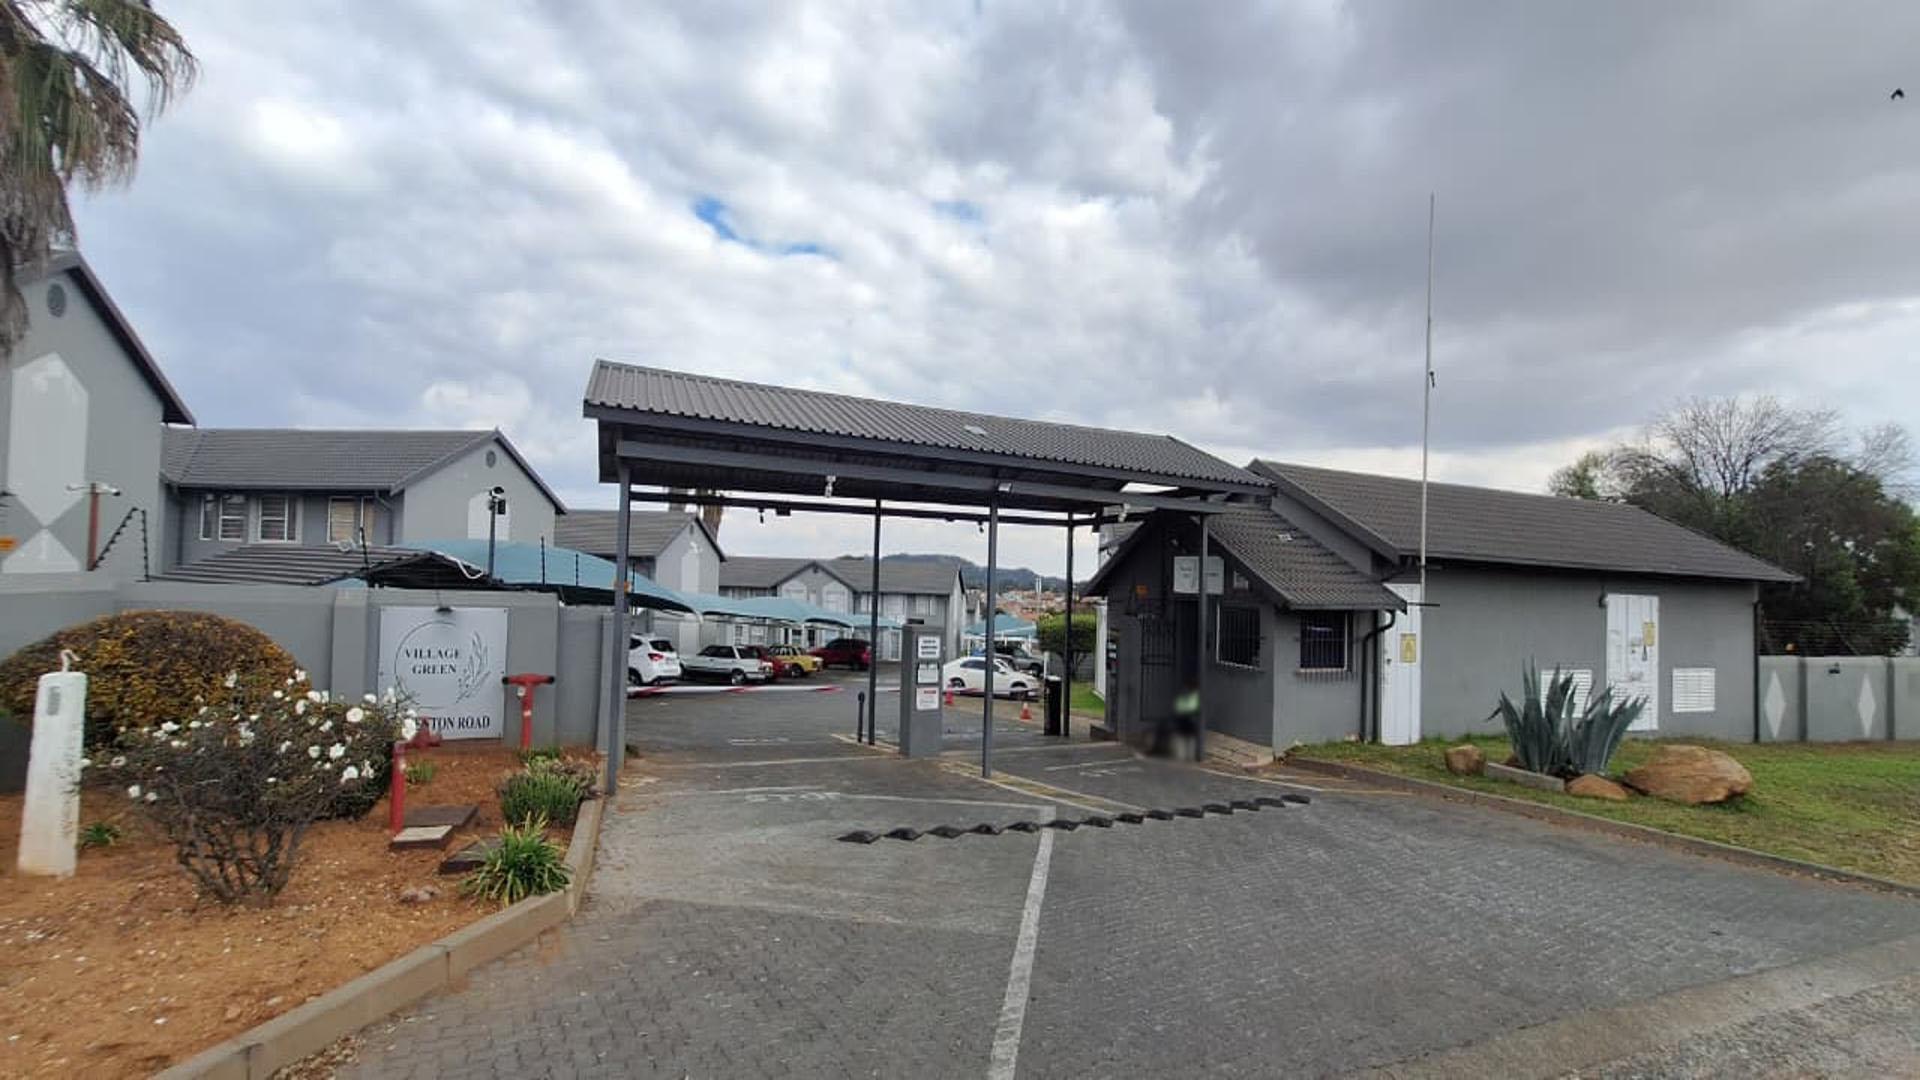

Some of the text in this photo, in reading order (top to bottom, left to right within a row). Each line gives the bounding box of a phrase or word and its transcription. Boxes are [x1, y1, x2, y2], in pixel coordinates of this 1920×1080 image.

[405, 648, 460, 661] VILLAGE
[411, 664, 457, 676] GREEN
[458, 715, 491, 730] ROAD
